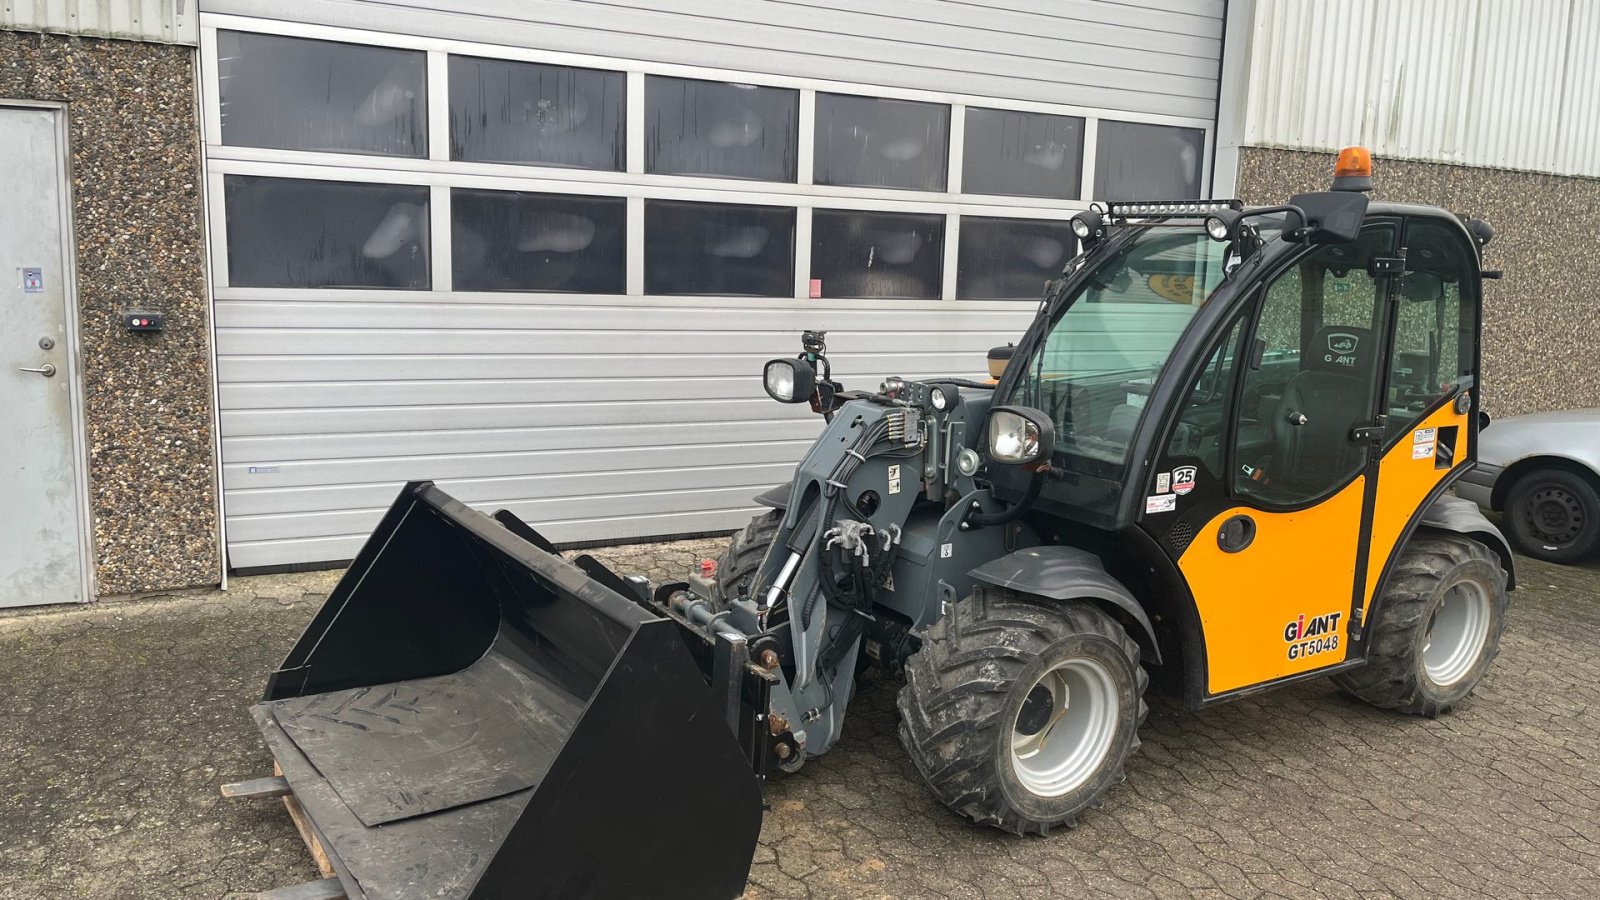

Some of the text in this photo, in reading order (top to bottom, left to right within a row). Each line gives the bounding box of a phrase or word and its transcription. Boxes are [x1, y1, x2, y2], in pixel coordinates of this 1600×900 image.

[1324, 354, 1356, 365] GANT
[1177, 470, 1193, 484] 25
[1288, 635, 1338, 660] GT5048
